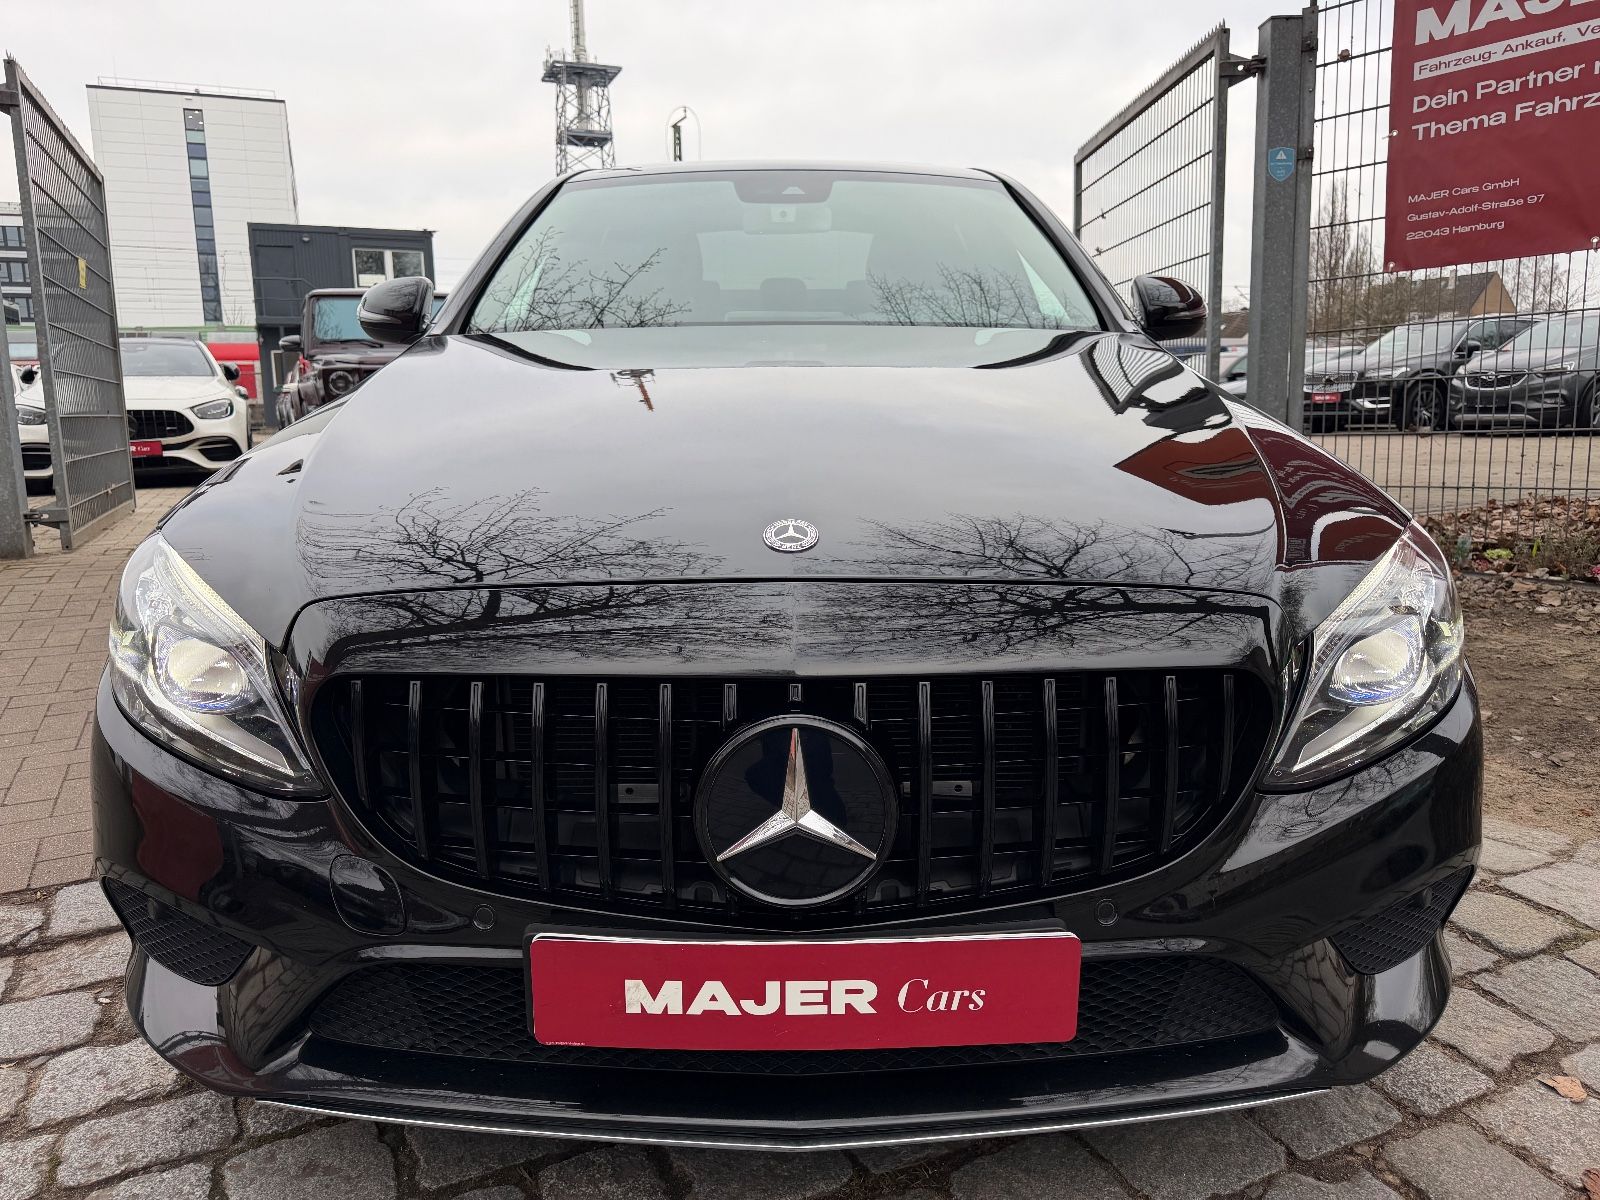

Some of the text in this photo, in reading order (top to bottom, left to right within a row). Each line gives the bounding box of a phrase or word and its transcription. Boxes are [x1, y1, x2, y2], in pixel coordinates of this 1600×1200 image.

[1418, 51, 1497, 75] Fahrzeug-
[1412, 89, 1468, 113] Dein
[1476, 63, 1585, 99] Partner
[1411, 91, 1600, 141] Thema Fahrz
[1408, 178, 1520, 204] MAJER Cars GmbH
[1407, 193, 1545, 222] Gustav-Adolf-Straße 97
[1406, 220, 1505, 241] 22043 Hamburg
[624, 978, 986, 1016] MAJER Cars
